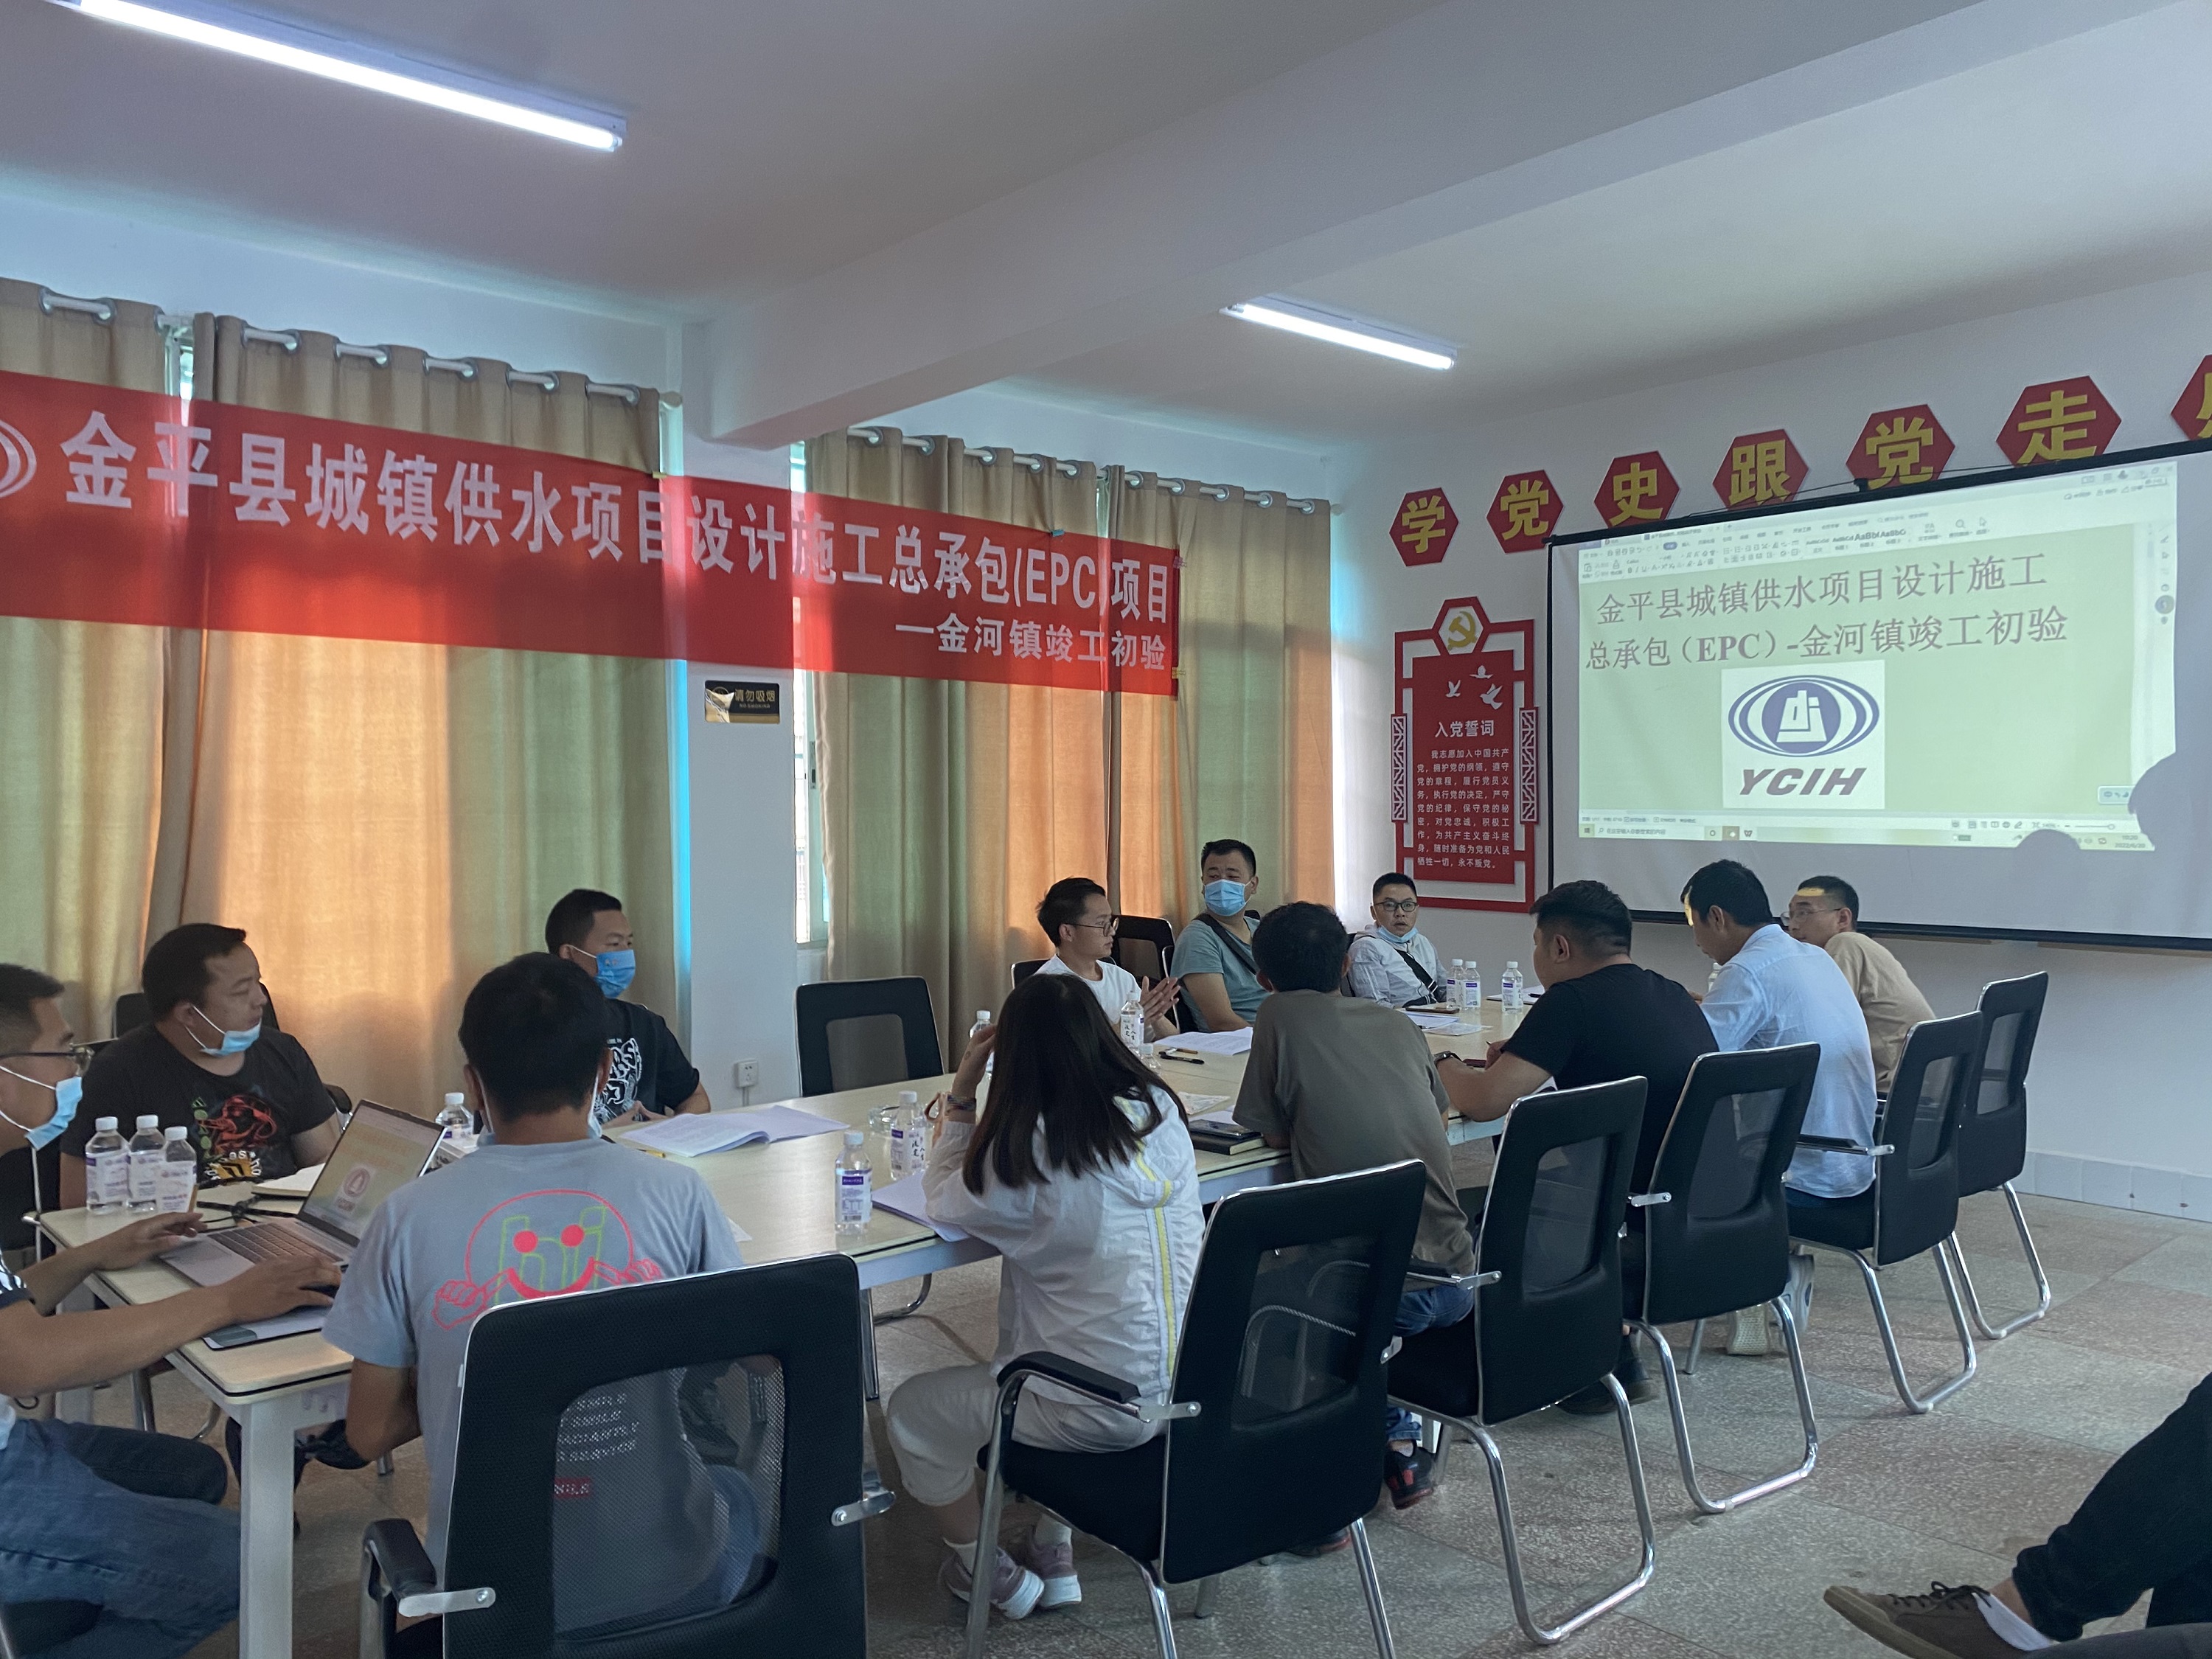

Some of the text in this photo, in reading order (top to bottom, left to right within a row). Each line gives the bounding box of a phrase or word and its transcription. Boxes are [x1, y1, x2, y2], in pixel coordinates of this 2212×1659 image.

[1596, 552, 2048, 625] 金平县城镇供水项目设计施工
[735, 689, 776, 702] 请勿吸烟
[1435, 720, 1495, 737] 入党誓词
[1431, 748, 1509, 759] 我志愿加入中国共产
[1739, 768, 1867, 796] YCIH
